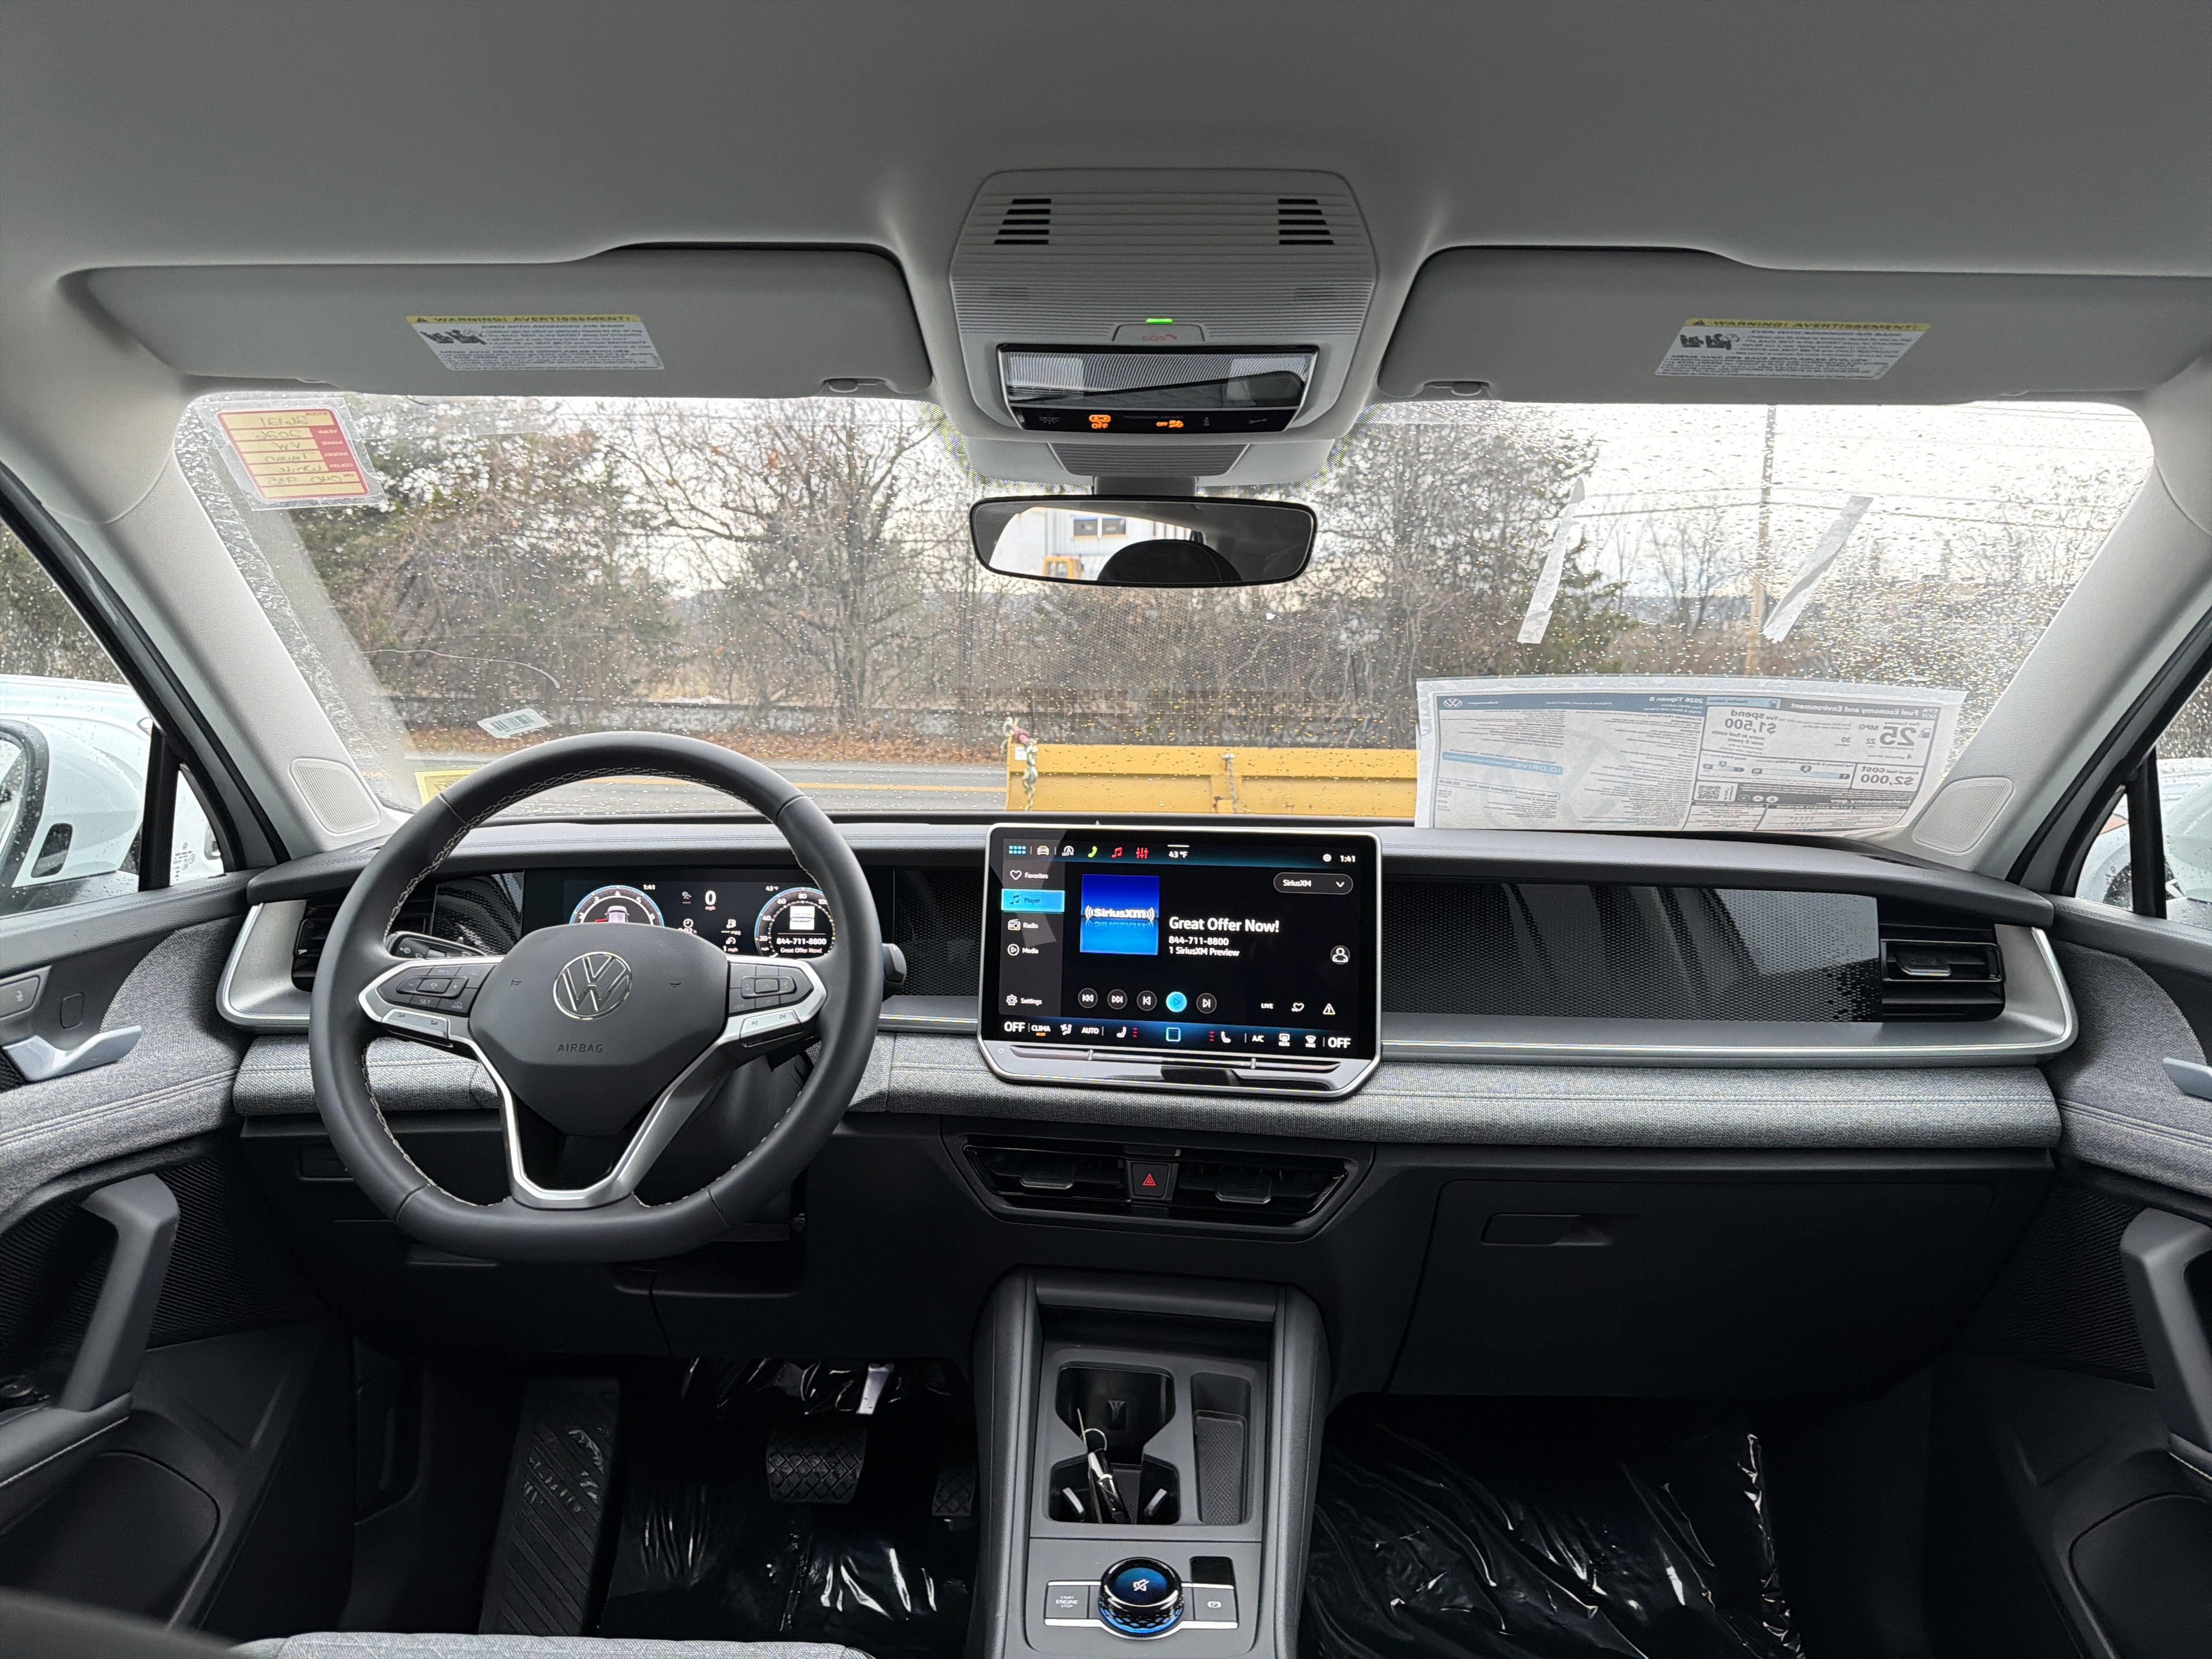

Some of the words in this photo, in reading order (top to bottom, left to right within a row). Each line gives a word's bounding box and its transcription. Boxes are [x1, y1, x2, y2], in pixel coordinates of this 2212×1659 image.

[705, 890, 716, 905] 0
[1024, 897, 1040, 905] Player
[1169, 916, 1204, 930] Great
[1207, 917, 1242, 932] Offer
[1245, 919, 1280, 933] Now!
[1169, 936, 1229, 946] 844-711-8800
[1176, 947, 1207, 956] SiriusXM
[1210, 947, 1240, 957] Preview
[1020, 998, 1042, 1006] Settings
[1004, 1022, 1025, 1032] OFF
[1081, 1026, 1099, 1035] AUTO
[1328, 1037, 1351, 1048] OFF
[557, 1043, 603, 1053] AIRBAG
